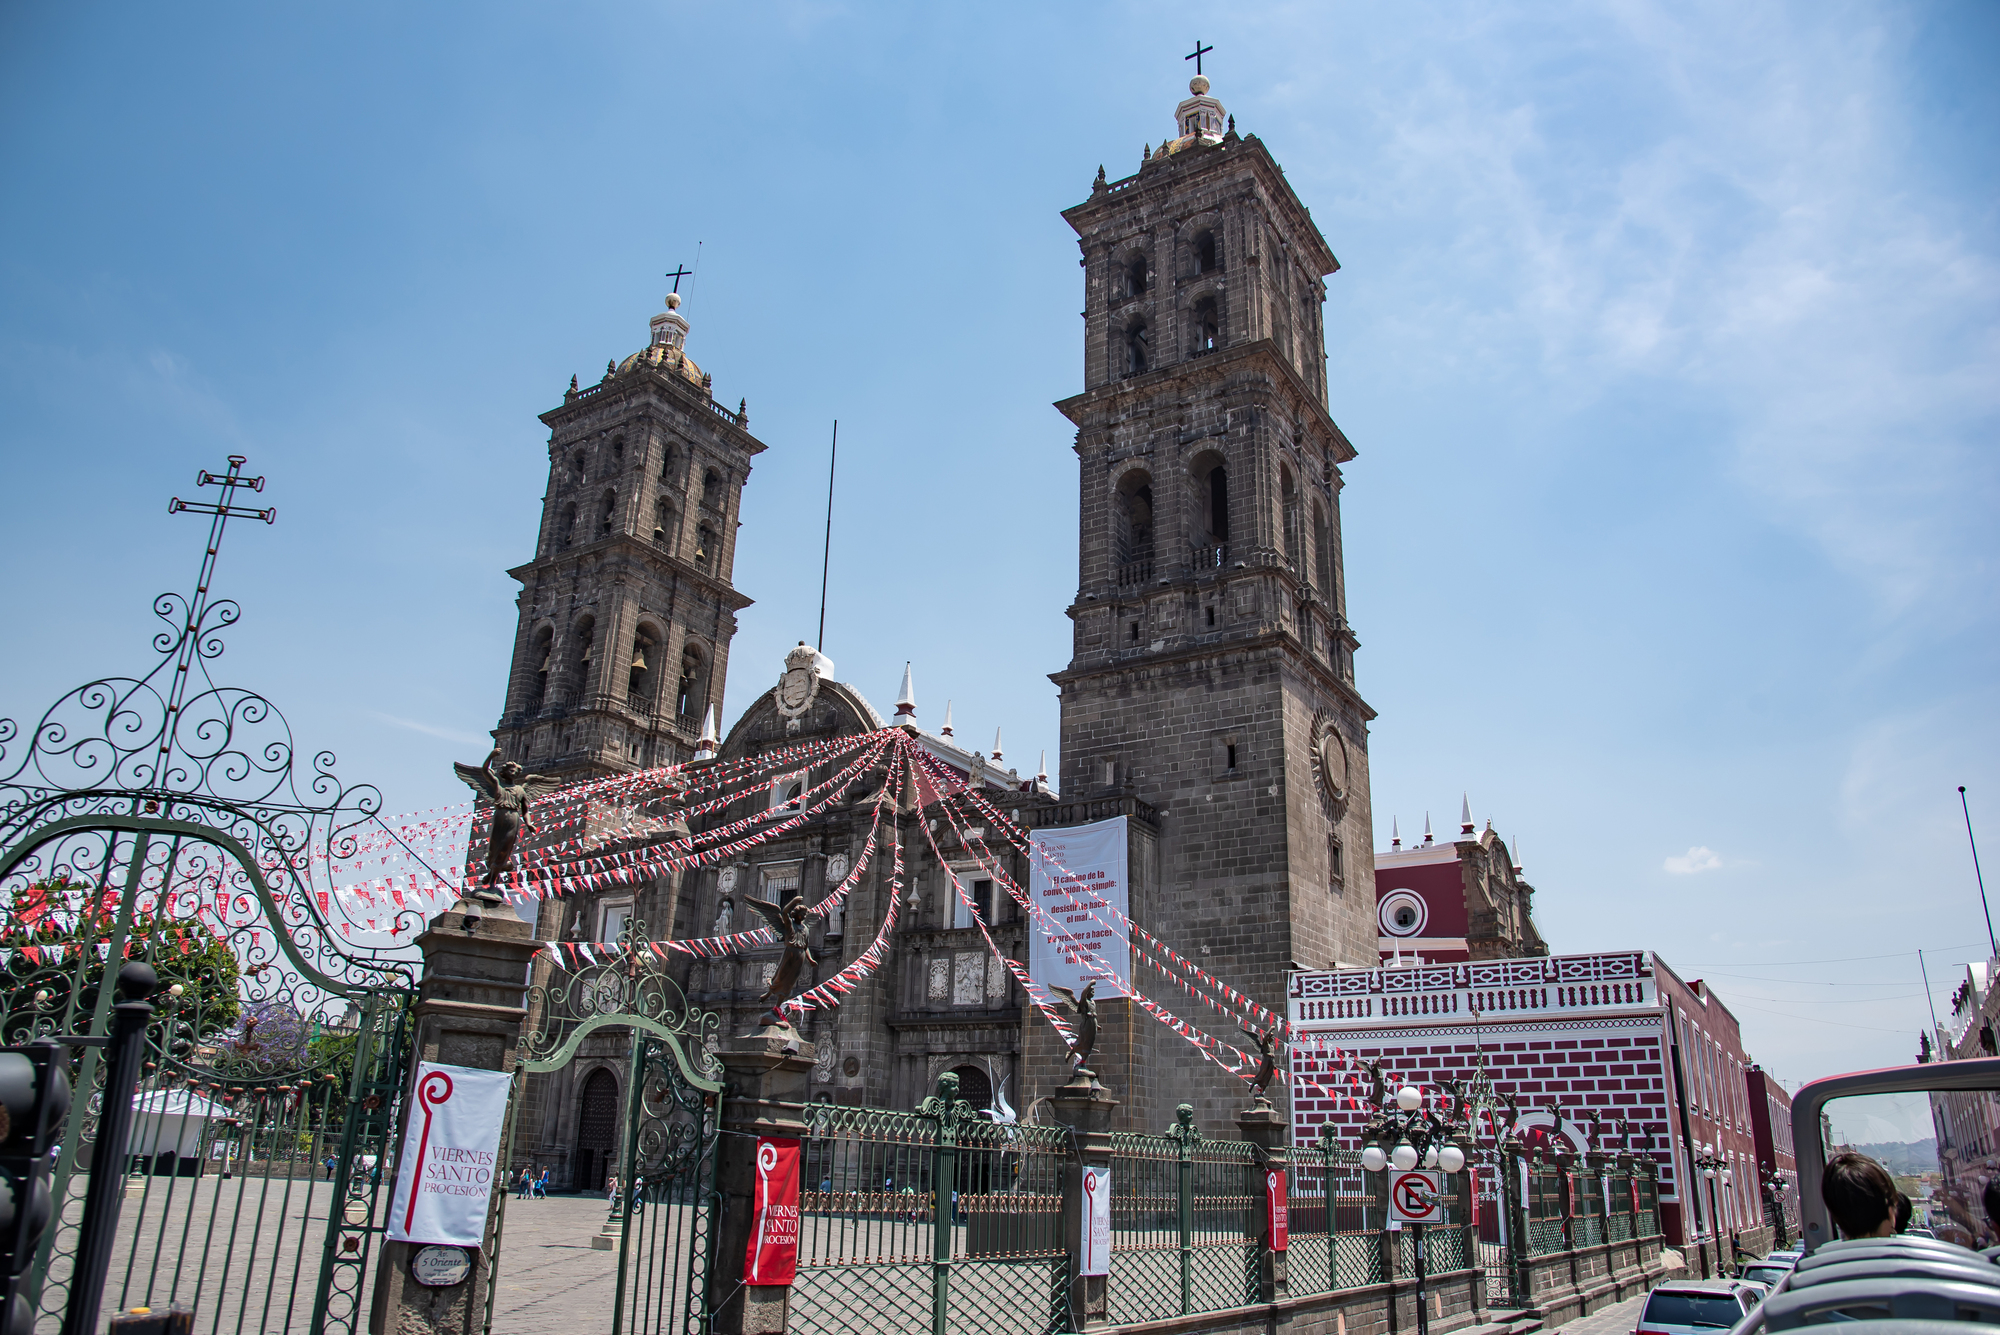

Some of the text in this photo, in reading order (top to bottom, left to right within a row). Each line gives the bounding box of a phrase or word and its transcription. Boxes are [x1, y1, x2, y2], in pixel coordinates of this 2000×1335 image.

[1087, 872, 1096, 880] de
[1097, 870, 1105, 879] la
[1091, 880, 1117, 891] simple:
[1066, 915, 1074, 923] el
[1074, 913, 1088, 922] mal
[1086, 931, 1091, 939] a
[1091, 929, 1113, 939] hacer
[431, 1146, 494, 1166] VIERNES
[426, 1163, 490, 1184] SANTO
[423, 1182, 488, 1198] PROCESIÓN
[1405, 1182, 1424, 1209] E
[769, 1205, 798, 1217] VIERNES
[765, 1218, 797, 1233] SANTO
[421, 1257, 462, 1267] 5 Oriente
